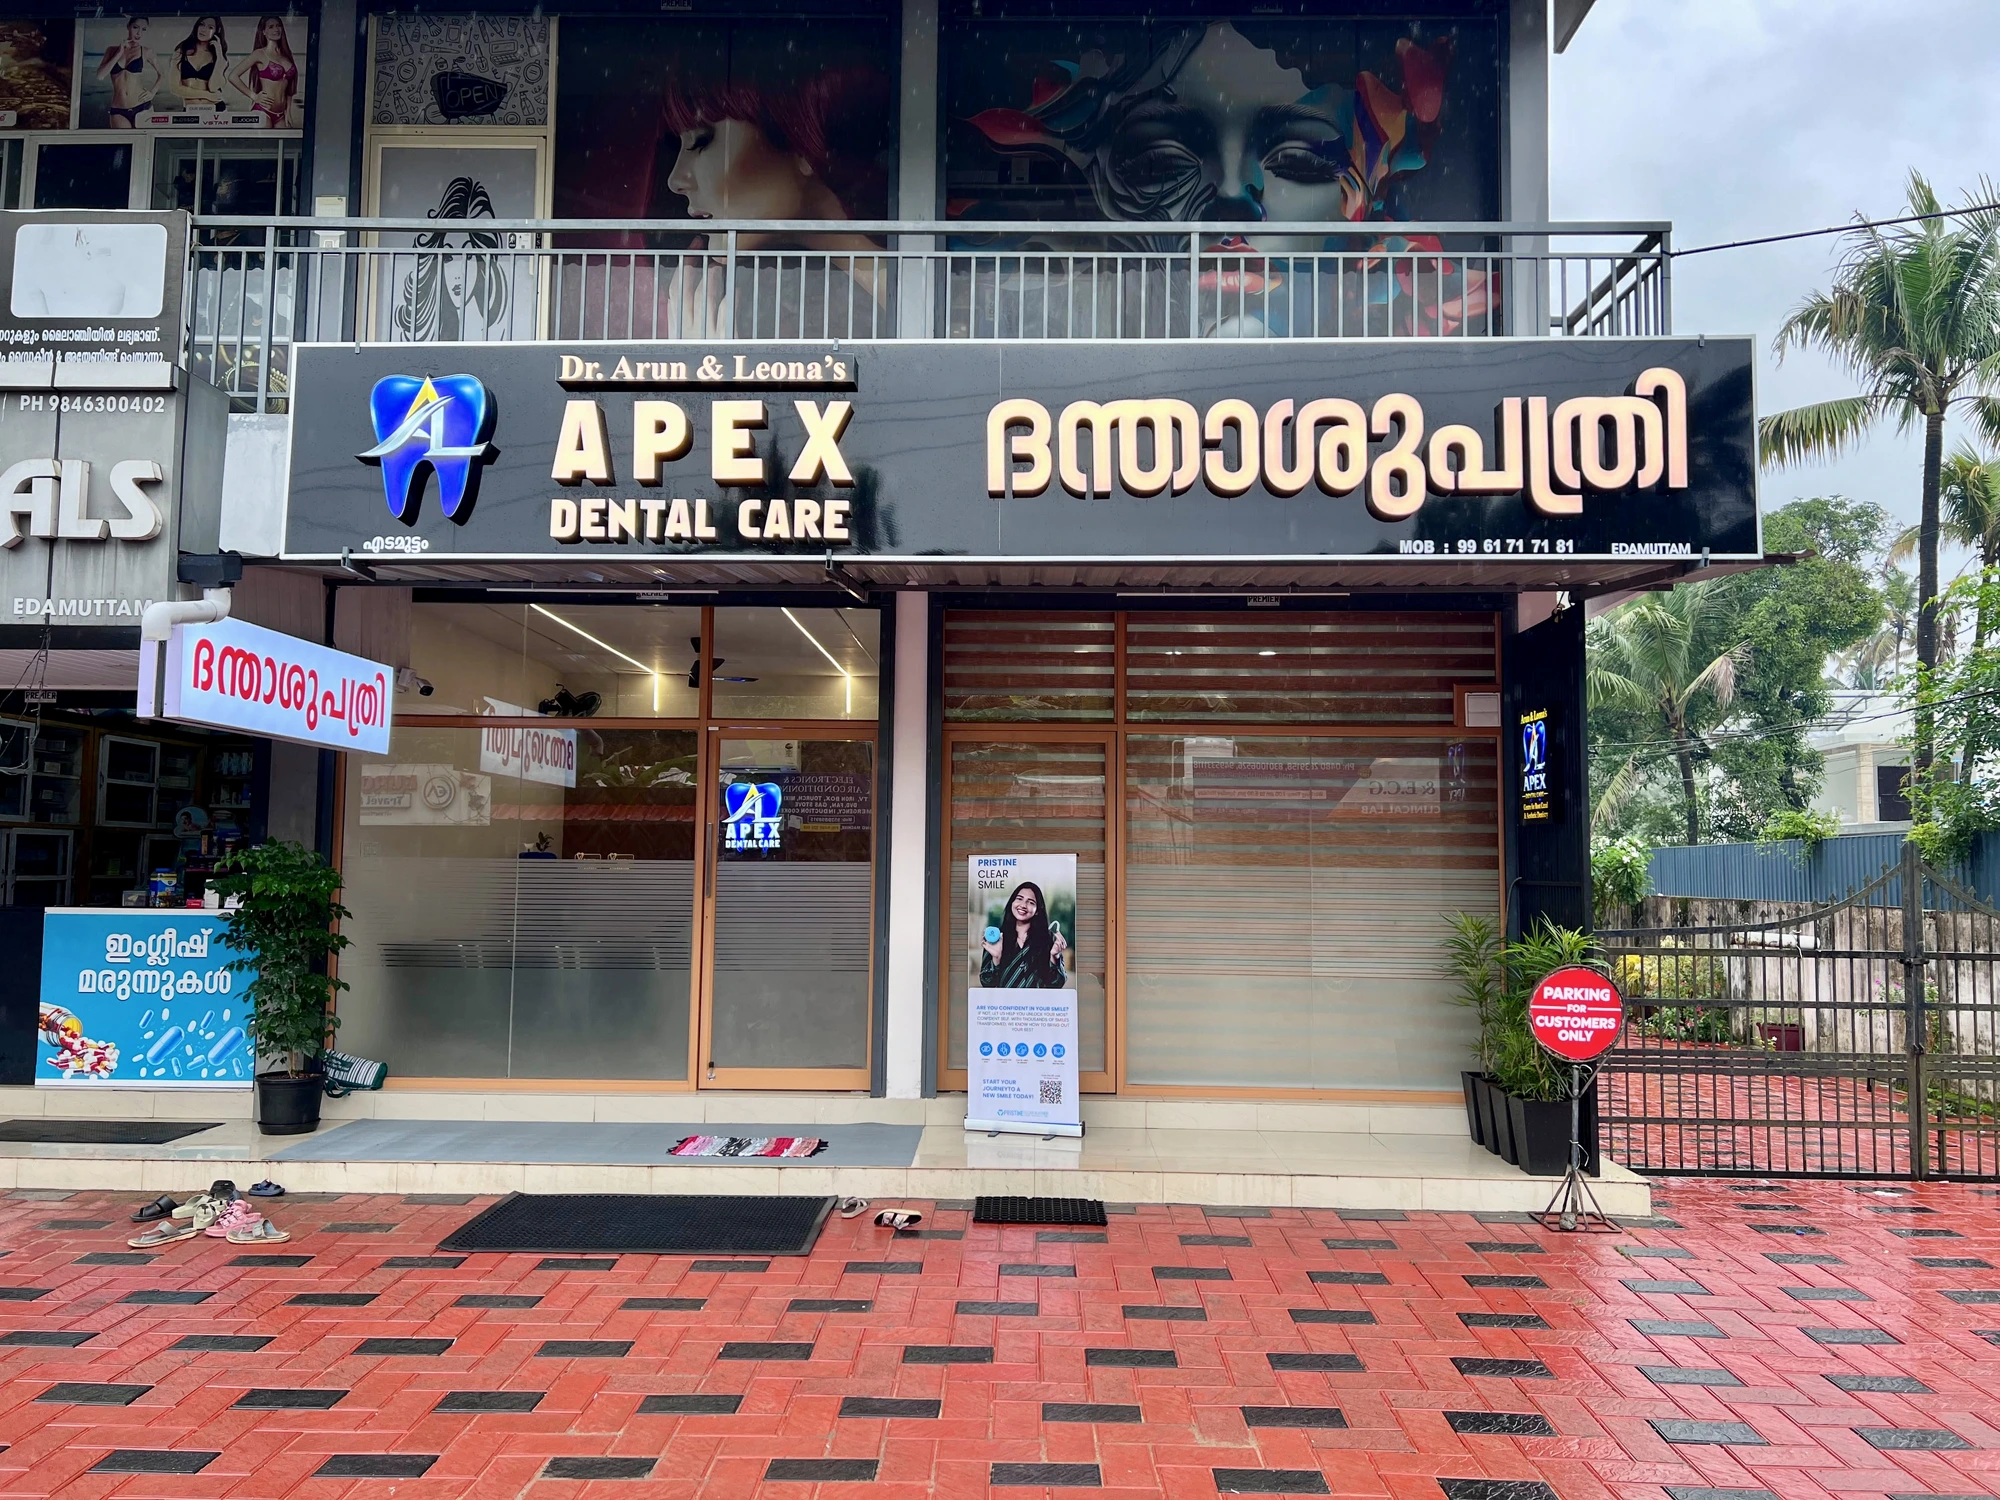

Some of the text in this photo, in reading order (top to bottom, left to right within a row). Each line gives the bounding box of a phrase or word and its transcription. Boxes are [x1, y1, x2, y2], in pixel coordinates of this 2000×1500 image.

[446, 84, 498, 108] OPEN
[559, 354, 847, 380] Dr. Arun & Leona’s
[20, 395, 165, 413] PH 9846300402
[551, 399, 855, 486] APEX
[986, 367, 1689, 517] ദന്താശുപത്രി
[550, 498, 851, 542] DENTAL CARE
[363, 535, 430, 553] എടമുട്ടം
[1400, 540, 1435, 553] MOB
[1457, 540, 1477, 553] 99
[1483, 540, 1500, 553] 61
[1506, 540, 1524, 553] 71
[1531, 540, 1549, 553] 71
[1556, 540, 1574, 553] 81
[1611, 543, 1691, 555] EDAMUTTAM
[13, 598, 154, 616] EDAMUTTAM
[192, 638, 386, 737] ദന്താശുപത്രി
[1523, 773, 1547, 792] APEX
[725, 823, 781, 838] APEX
[725, 839, 781, 848] DENTAL CARE
[978, 858, 1017, 867] PRISTINE
[977, 869, 1009, 879] CLEAR
[977, 880, 1005, 889] SMILE
[105, 928, 213, 966] ഇംഗ്ലീഷ്
[78, 967, 232, 1001] മരുന്നുകൾ
[1543, 986, 1611, 1001] PARKING
[1566, 1004, 1587, 1013] FOR
[1536, 1015, 1616, 1029] CUSTOMERS
[1558, 1029, 1594, 1042] ONLY
